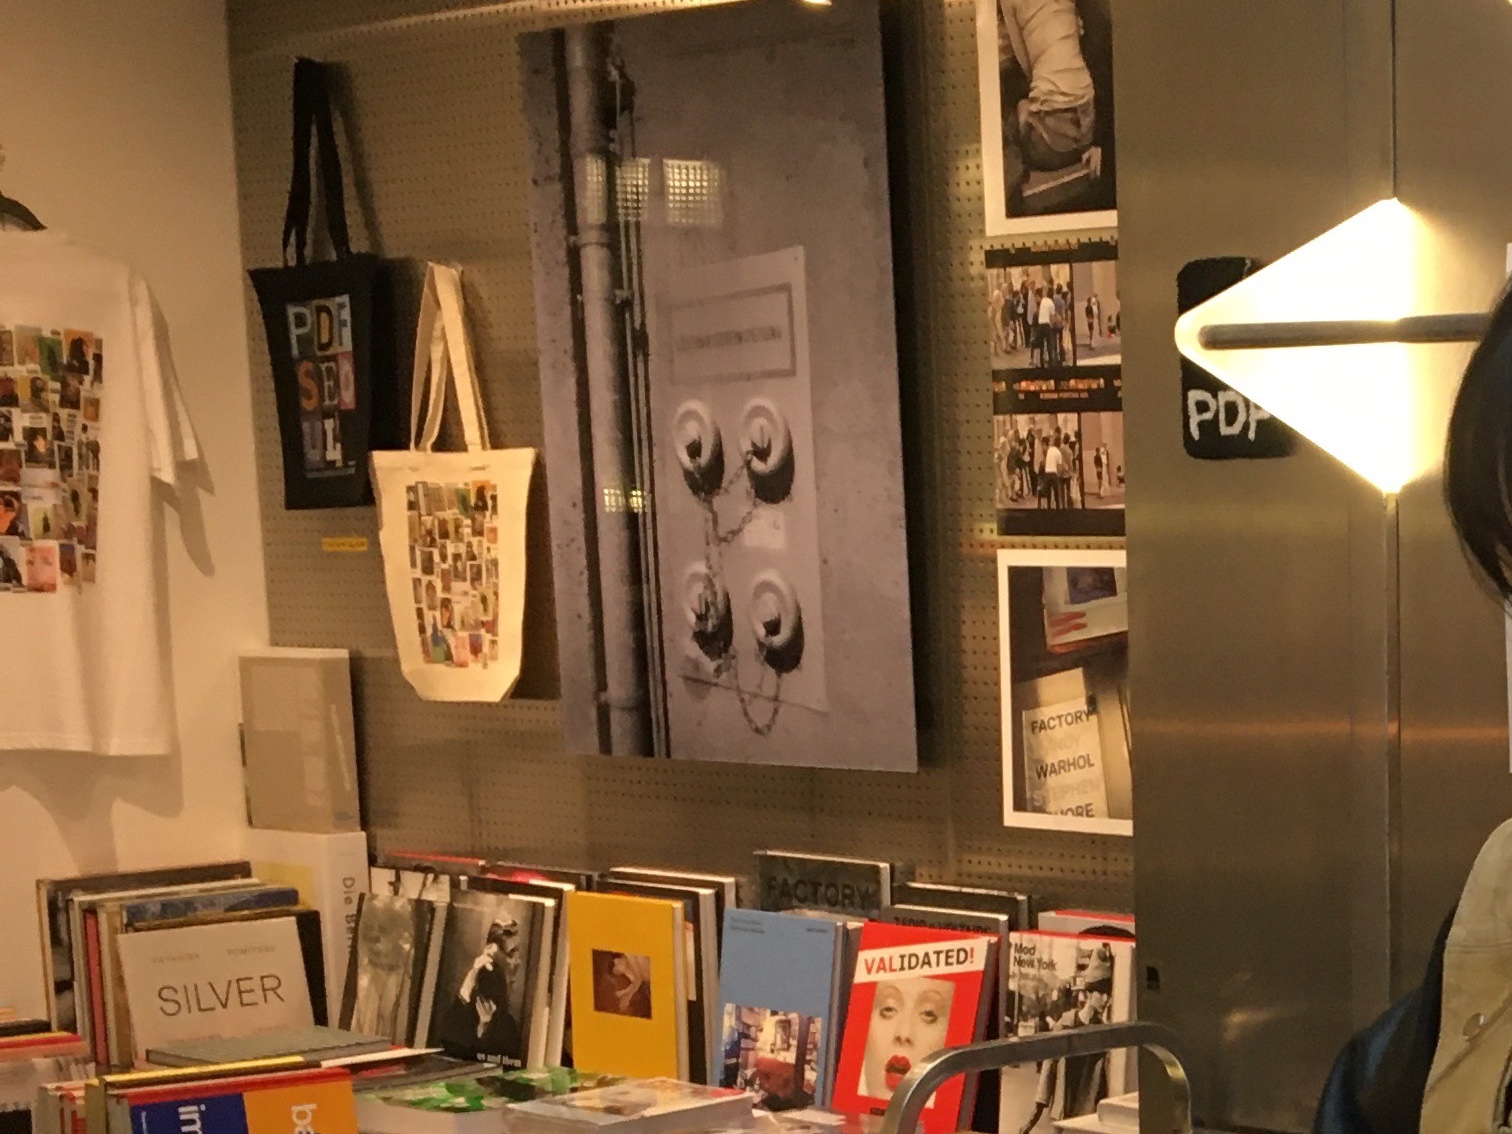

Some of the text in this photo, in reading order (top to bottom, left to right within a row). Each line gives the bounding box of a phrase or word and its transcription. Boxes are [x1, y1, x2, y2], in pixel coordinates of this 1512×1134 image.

[287, 300, 349, 361] PDF
[1030, 709, 1091, 735] FACTORY
[1035, 753, 1095, 780] WARHOL
[343, 877, 355, 905] Die
[766, 876, 872, 911] FACTORY
[864, 947, 974, 975] VALIDATED!
[1014, 942, 1036, 956] Mod
[1013, 956, 1057, 971] New York
[158, 974, 285, 1016] SILVER
